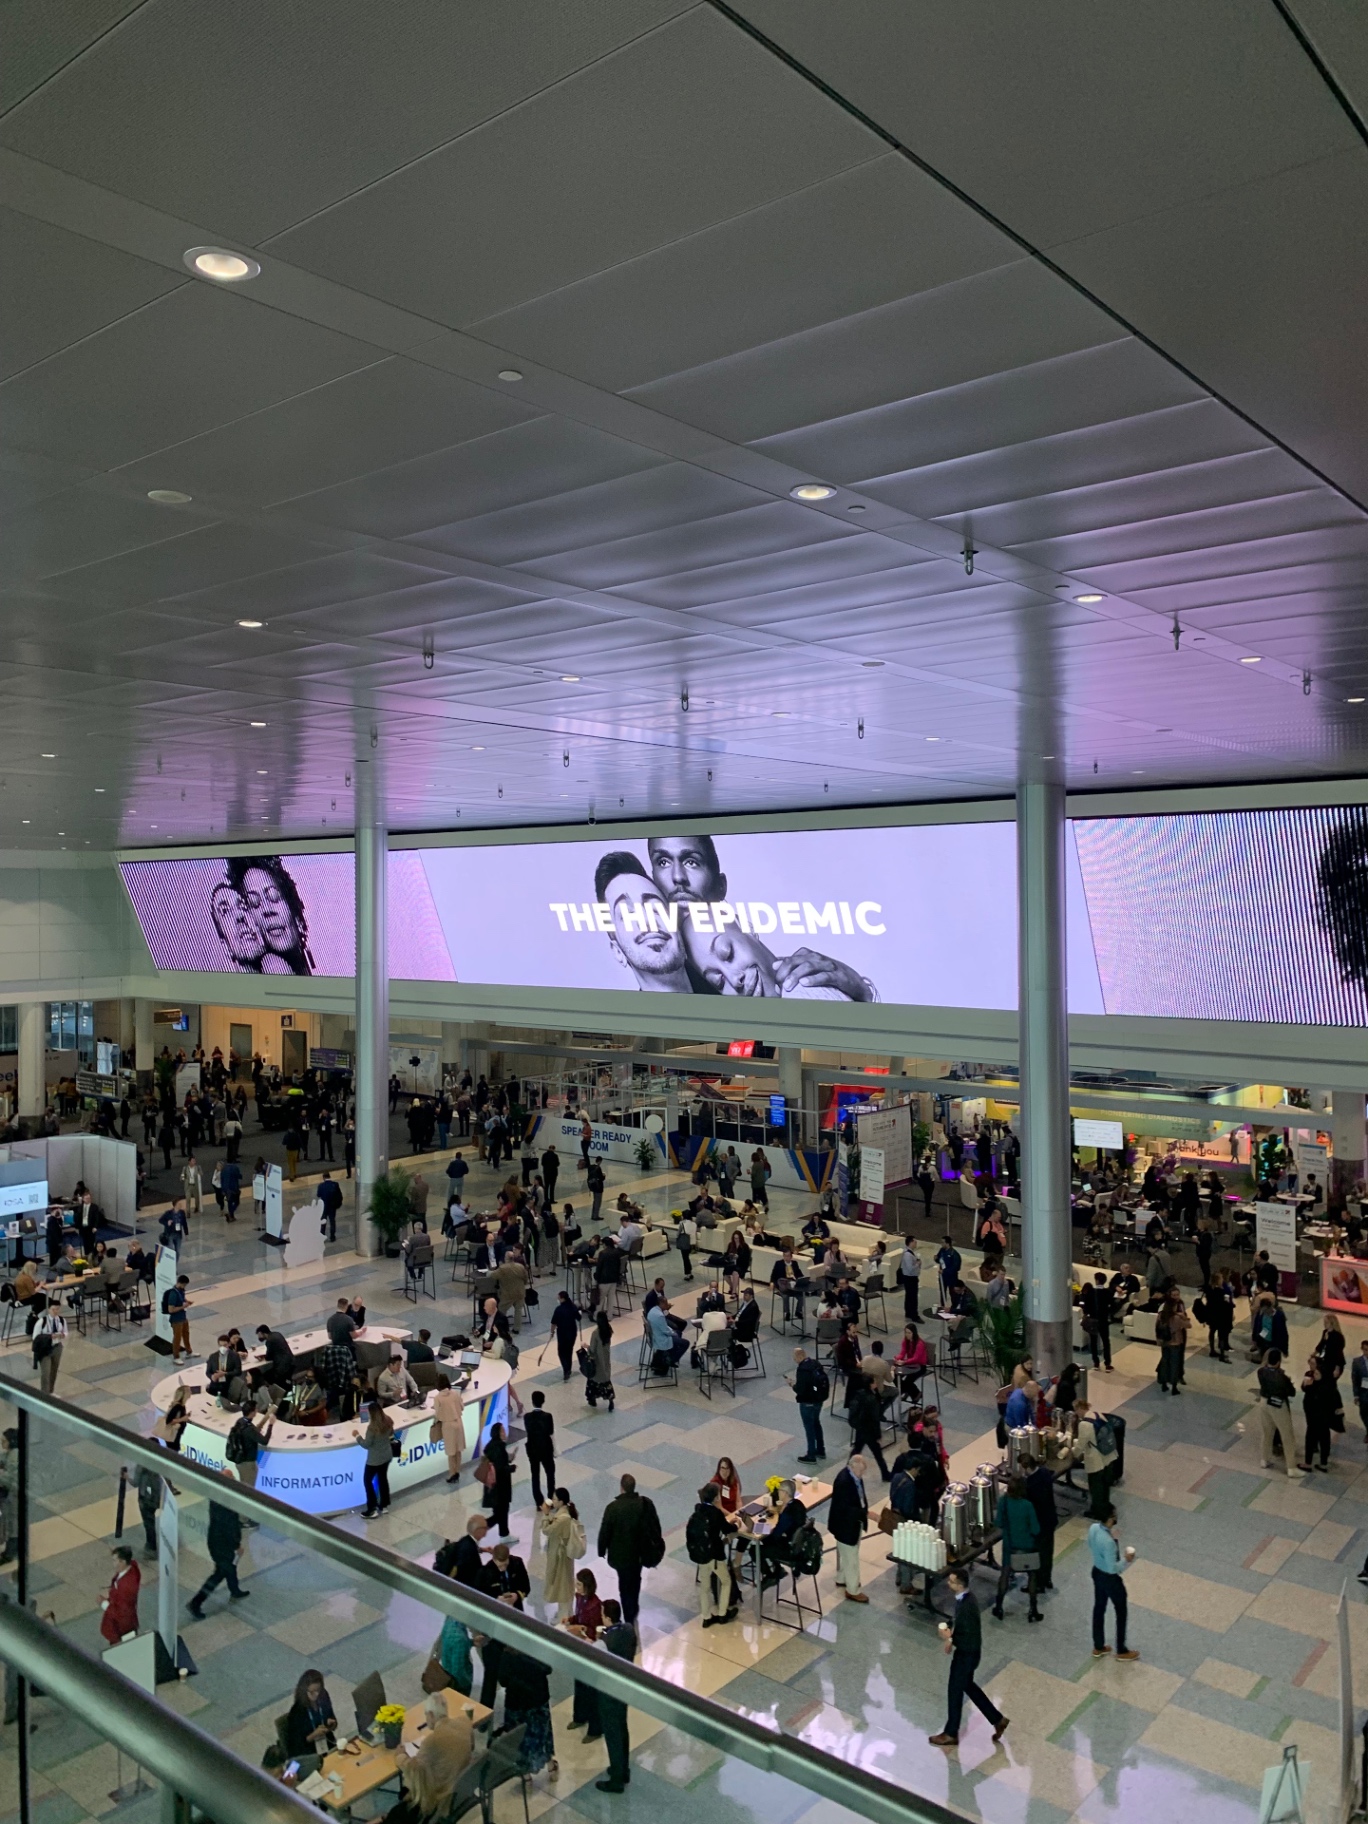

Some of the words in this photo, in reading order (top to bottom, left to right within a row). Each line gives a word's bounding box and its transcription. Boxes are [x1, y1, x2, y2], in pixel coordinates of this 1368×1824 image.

[549, 903, 617, 933] THE
[617, 902, 680, 933] HIV
[688, 901, 887, 936] EPIDEMIC
[561, 1125, 601, 1140] SPEAER
[602, 1130, 632, 1144] READY
[589, 1140, 609, 1152] OOM
[186, 1445, 228, 1472] IDWeek
[409, 1439, 446, 1464] IDWe
[260, 1471, 354, 1490] INFORMATION
